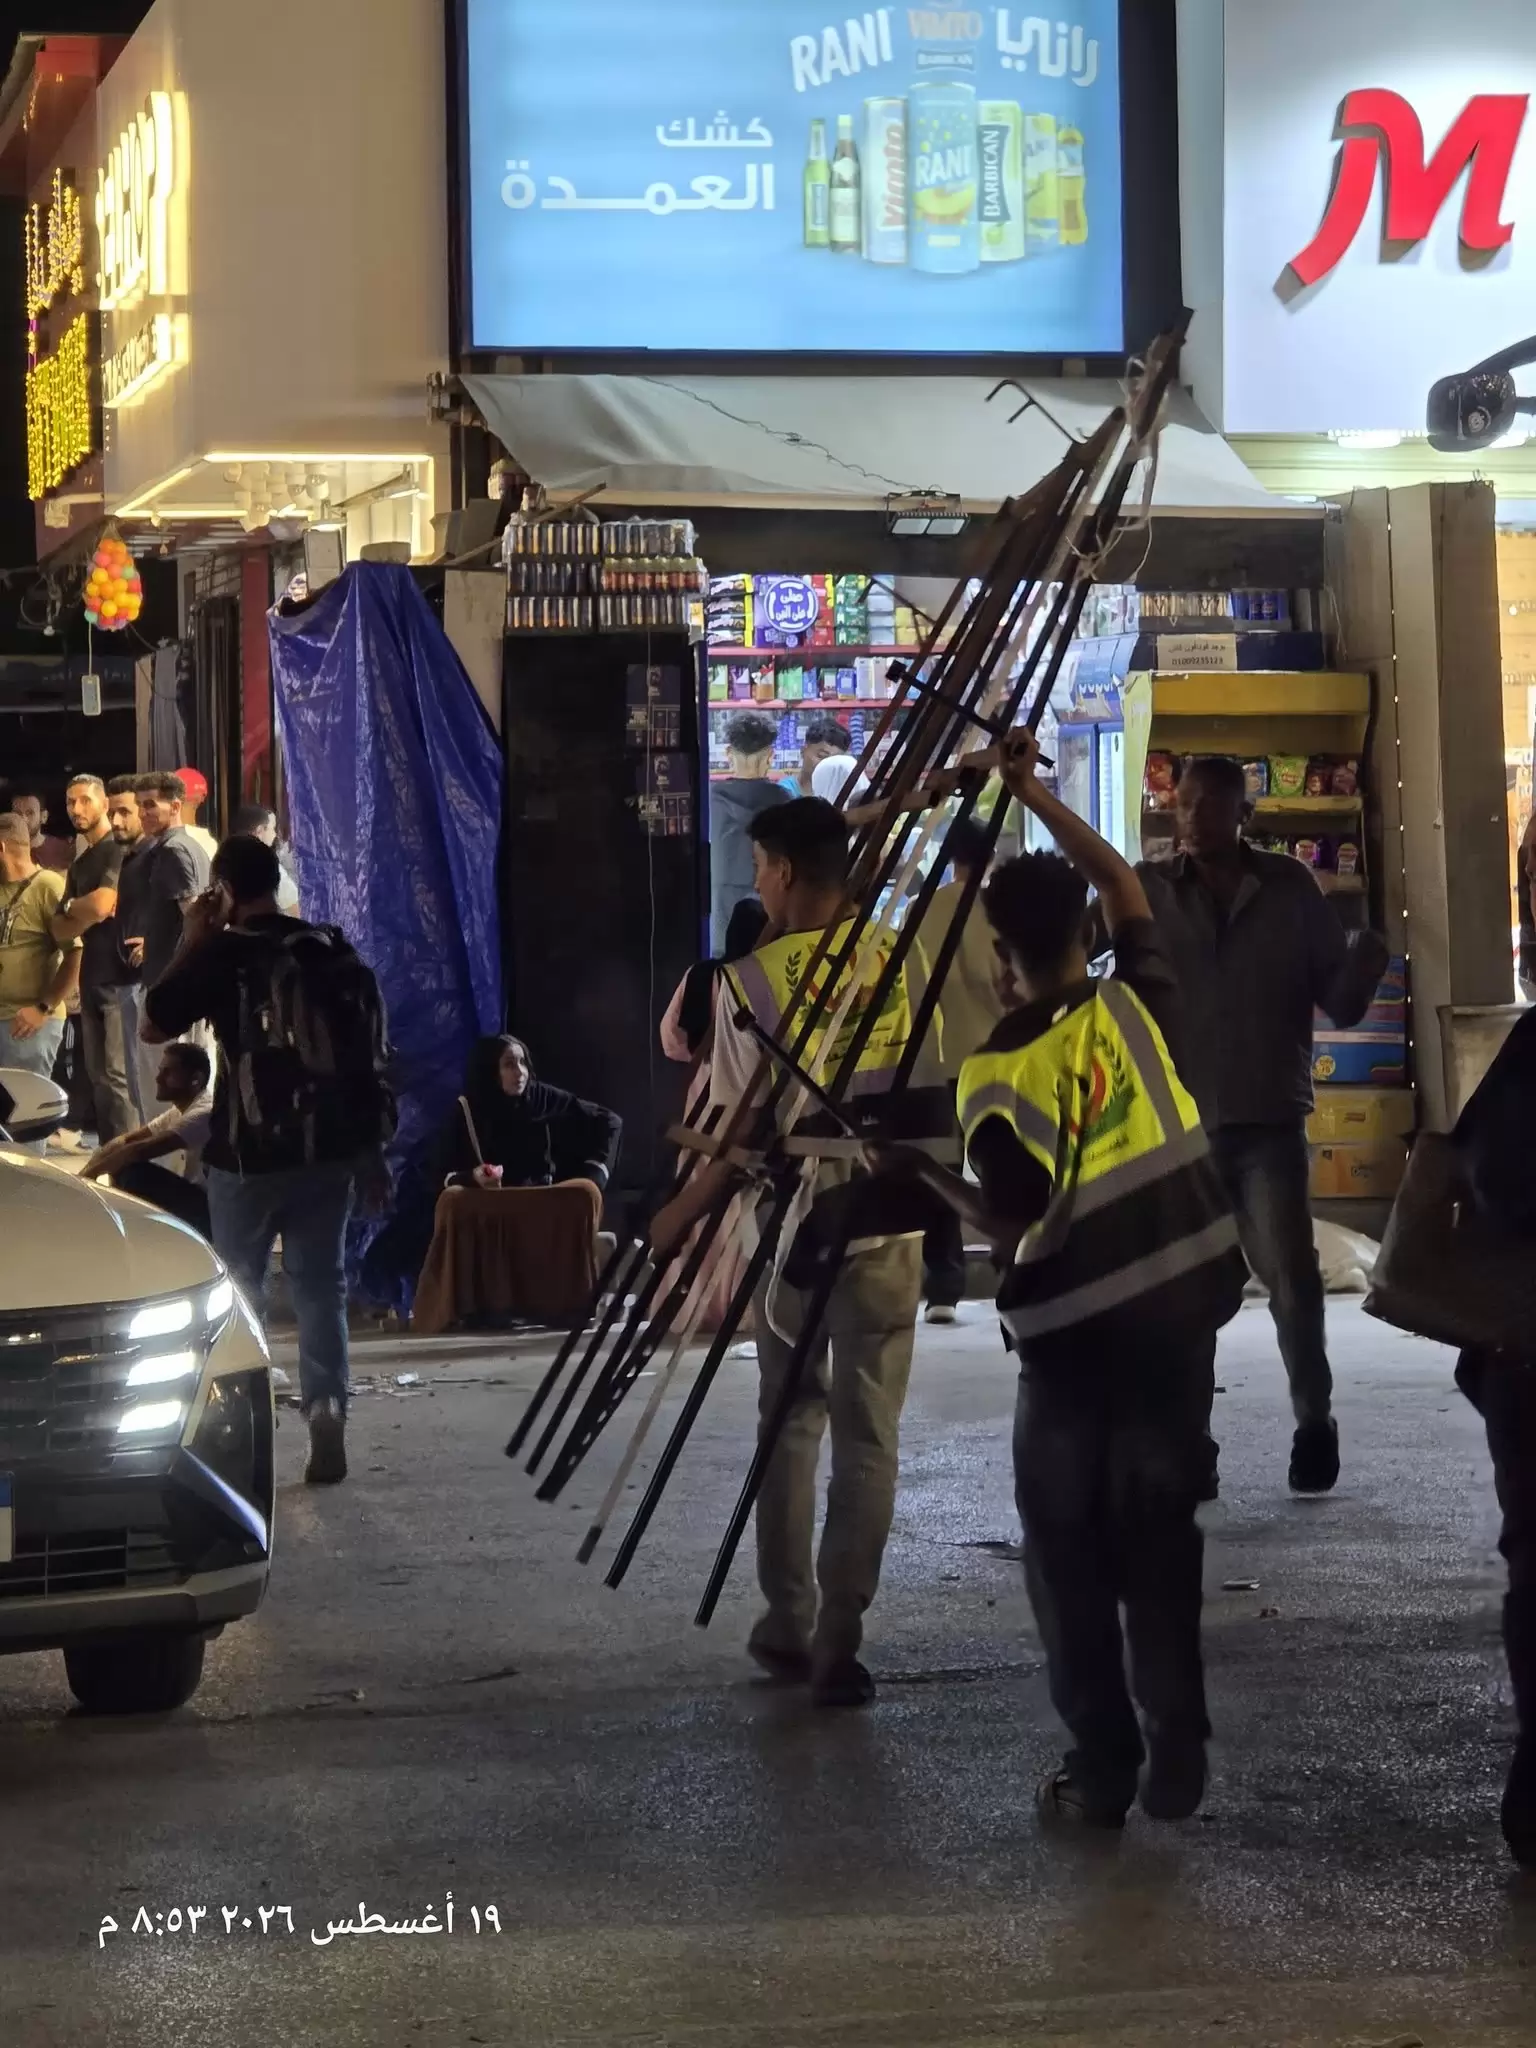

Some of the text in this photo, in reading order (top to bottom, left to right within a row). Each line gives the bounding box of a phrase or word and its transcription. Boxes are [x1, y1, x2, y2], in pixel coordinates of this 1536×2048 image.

[790, 8, 893, 93] RANI
[907, 8, 984, 41] VIMTO
[997, 8, 1098, 87] راني
[655, 110, 774, 148] كشك
[501, 159, 775, 215] العمدة
[915, 145, 973, 187] RANI
[982, 130, 1000, 217] BARBICAN
